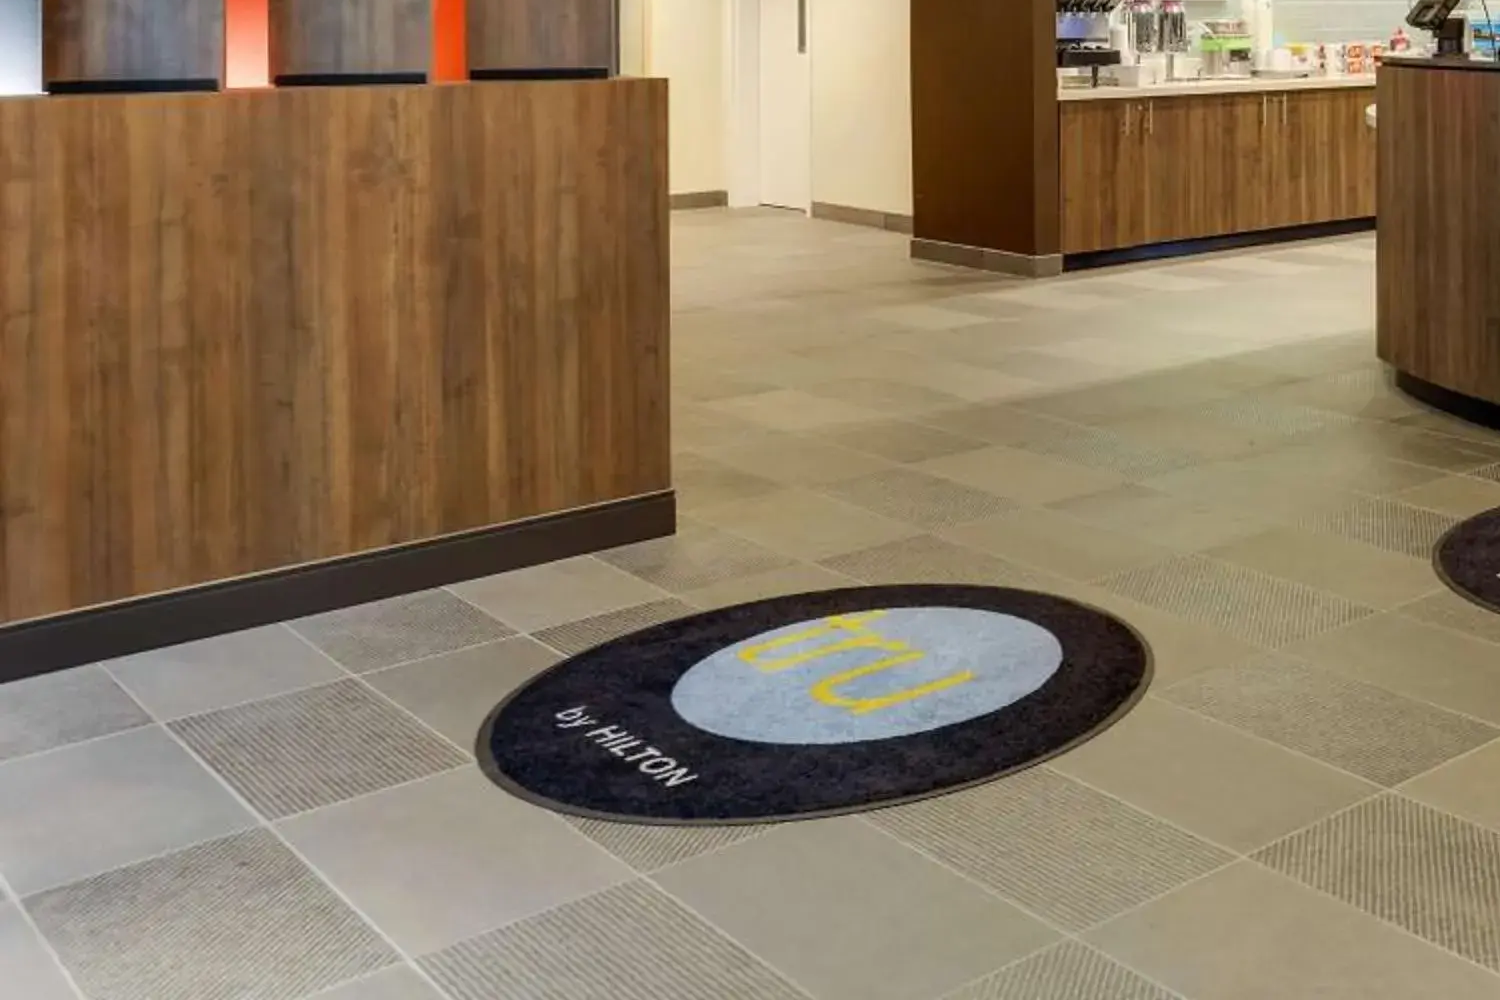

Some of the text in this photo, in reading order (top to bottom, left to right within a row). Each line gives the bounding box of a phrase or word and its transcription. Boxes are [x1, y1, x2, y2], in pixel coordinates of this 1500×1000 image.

[737, 609, 976, 716] tru
[555, 706, 699, 787] by HILTON
